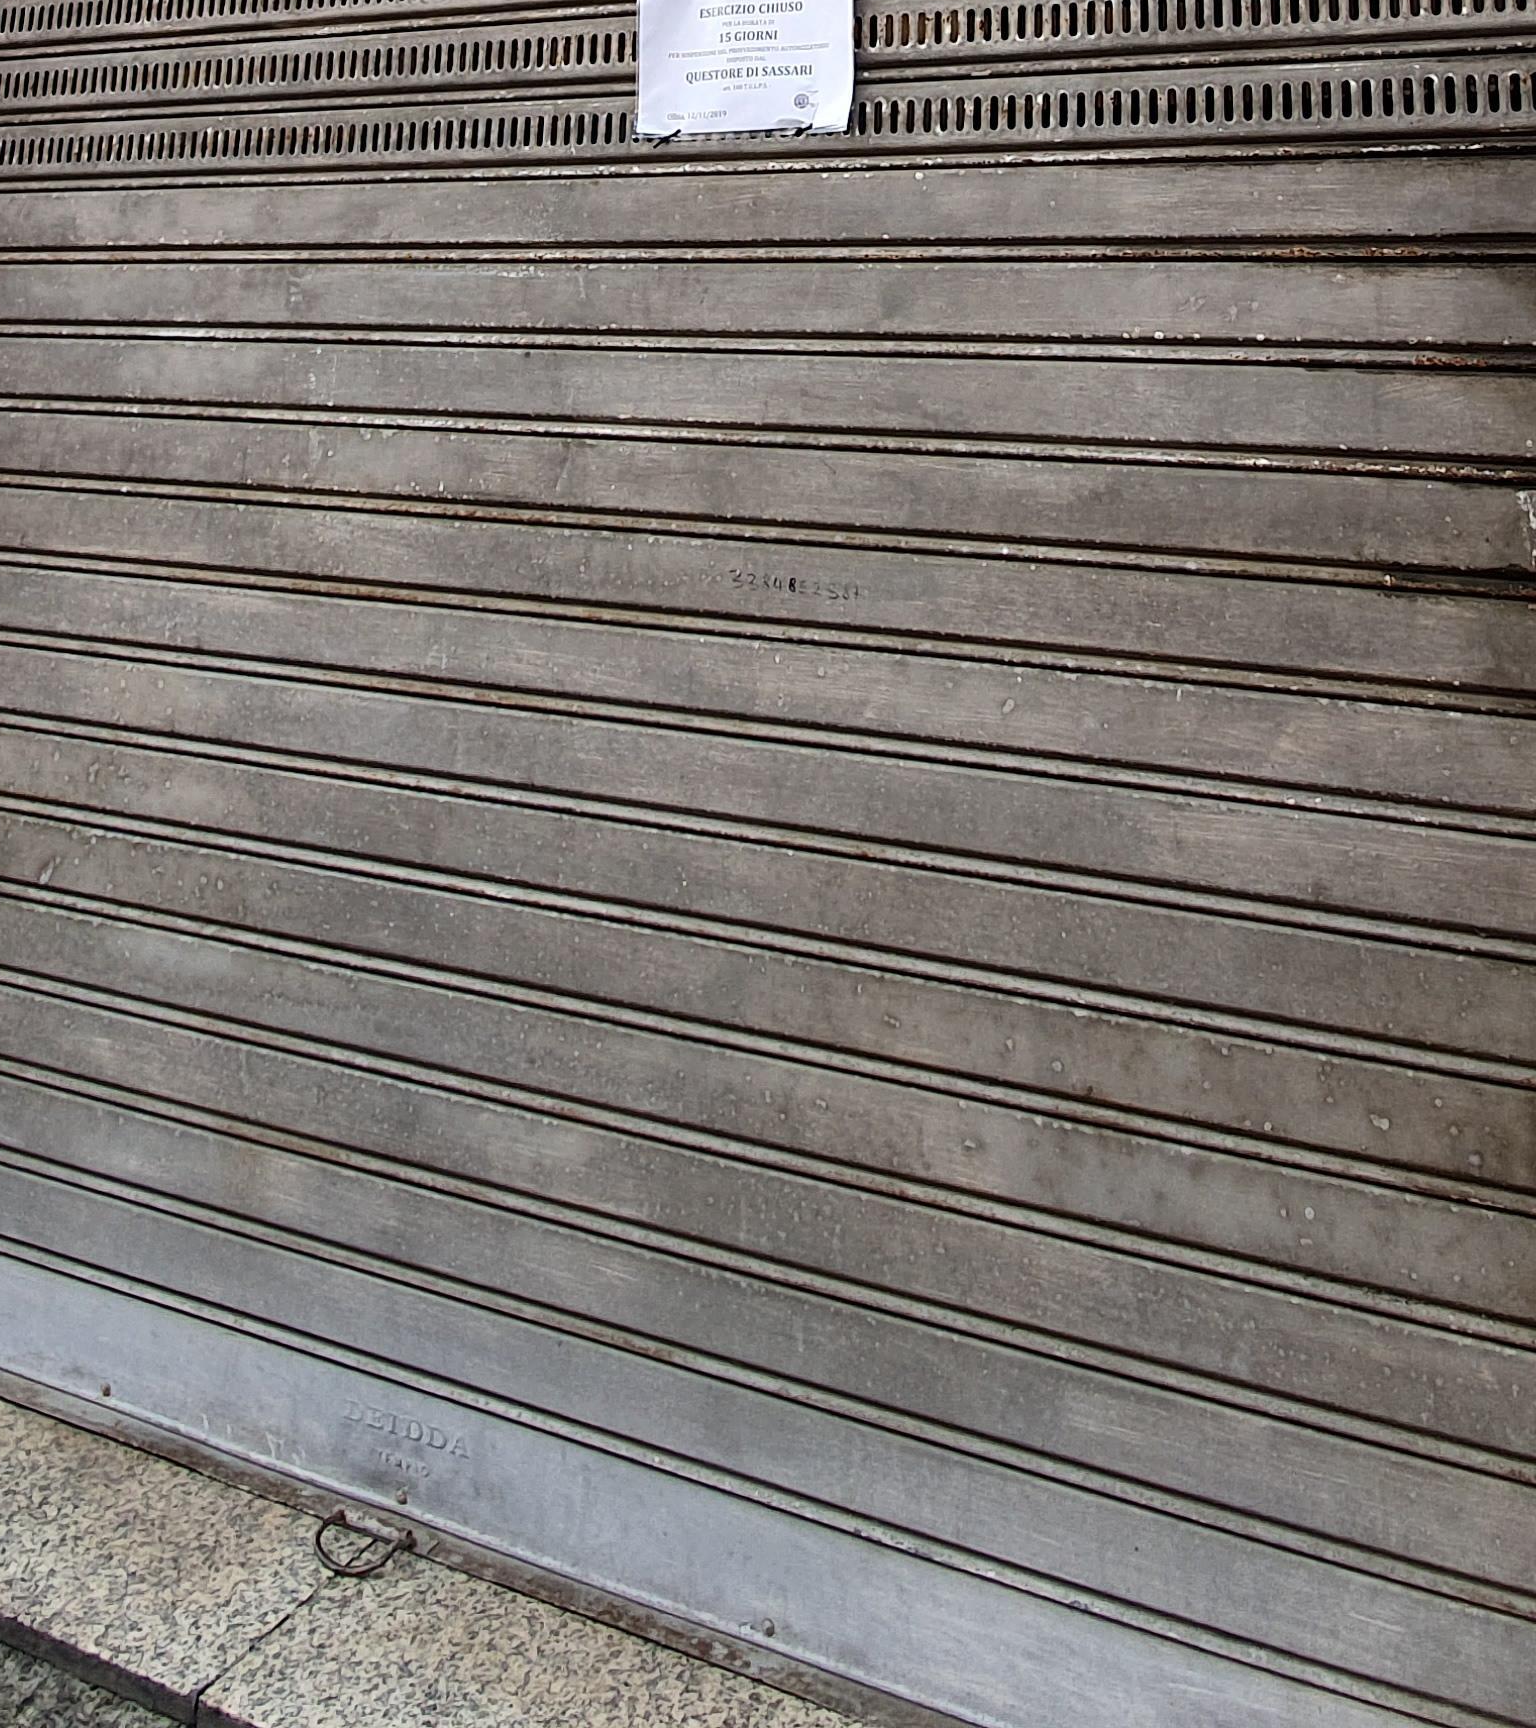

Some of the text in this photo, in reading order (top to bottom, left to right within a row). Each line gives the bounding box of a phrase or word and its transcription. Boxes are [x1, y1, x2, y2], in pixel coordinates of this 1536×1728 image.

[699, 1, 803, 19] ESERCIZIO CHIUSO
[719, 30, 778, 43] 15 GIORNI
[686, 65, 813, 84] QUESTORE DI SASSARI
[343, 1397, 471, 1460] DEIDDA
